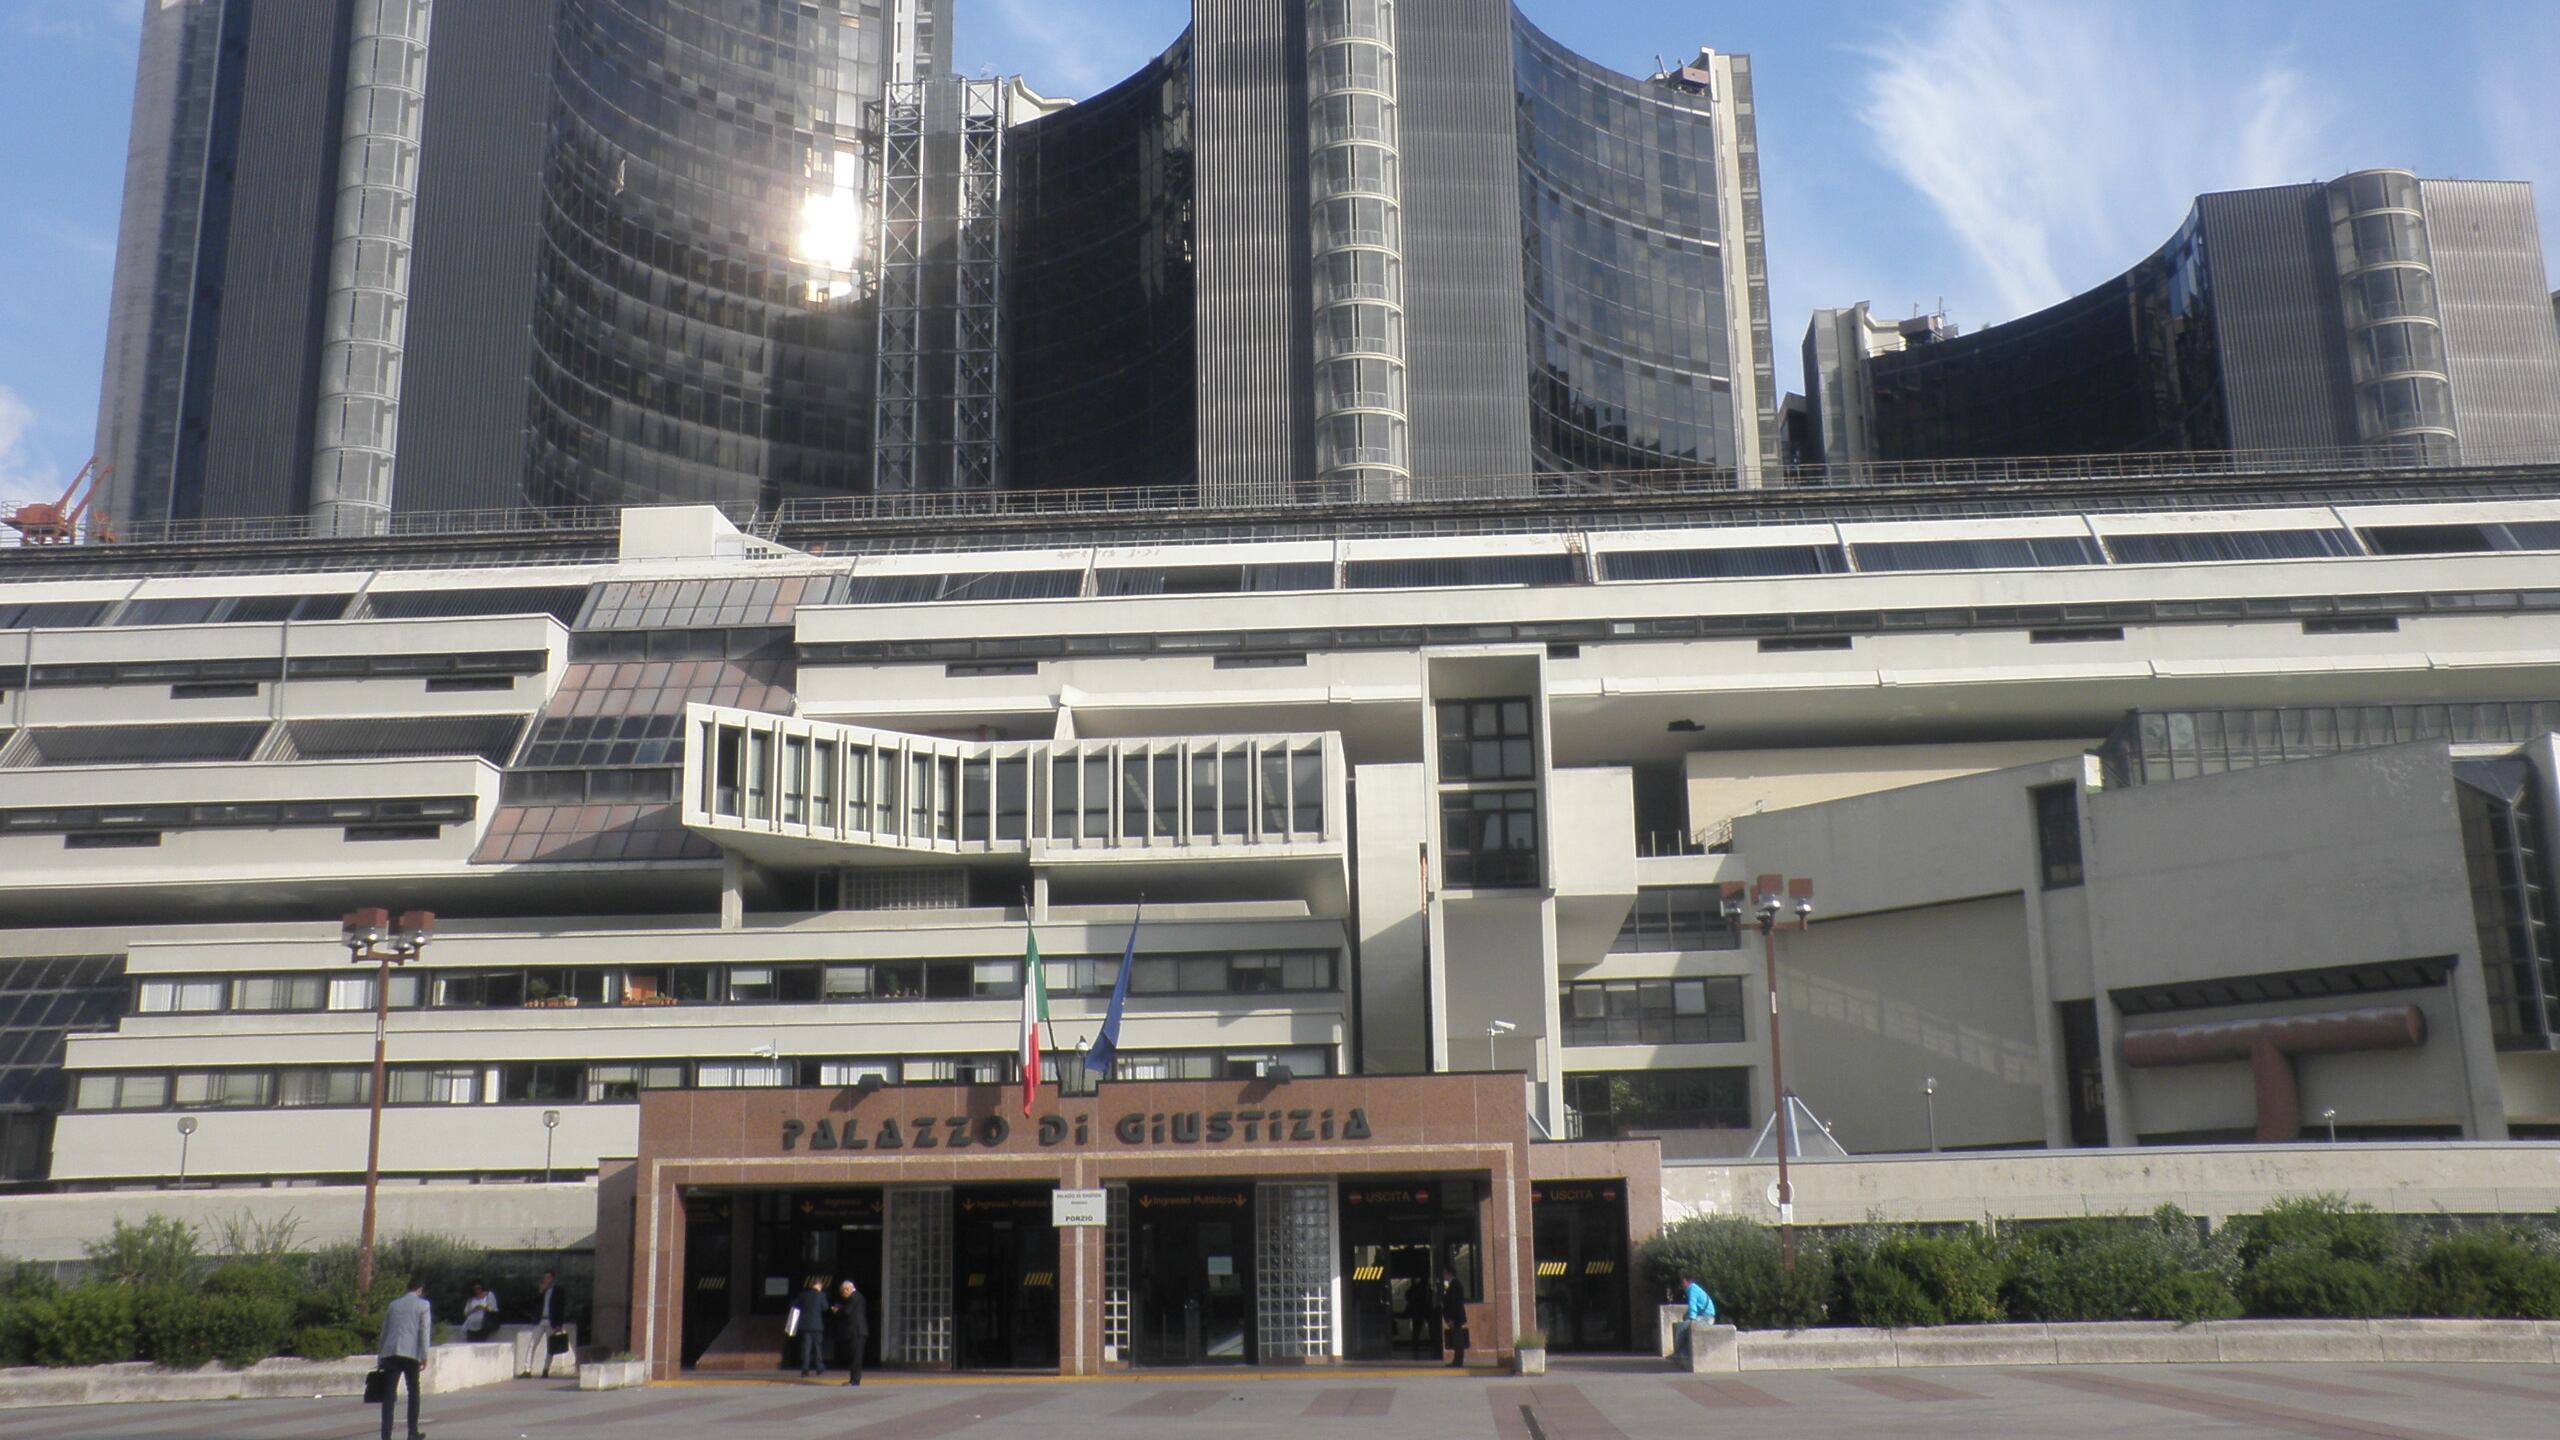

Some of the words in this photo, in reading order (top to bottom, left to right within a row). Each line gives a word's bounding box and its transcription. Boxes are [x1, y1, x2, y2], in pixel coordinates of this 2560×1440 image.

[781, 1115, 1010, 1150] PALAZZO
[1365, 1191, 1409, 1202] USCITA
[1550, 1189, 1594, 1201] USCITA
